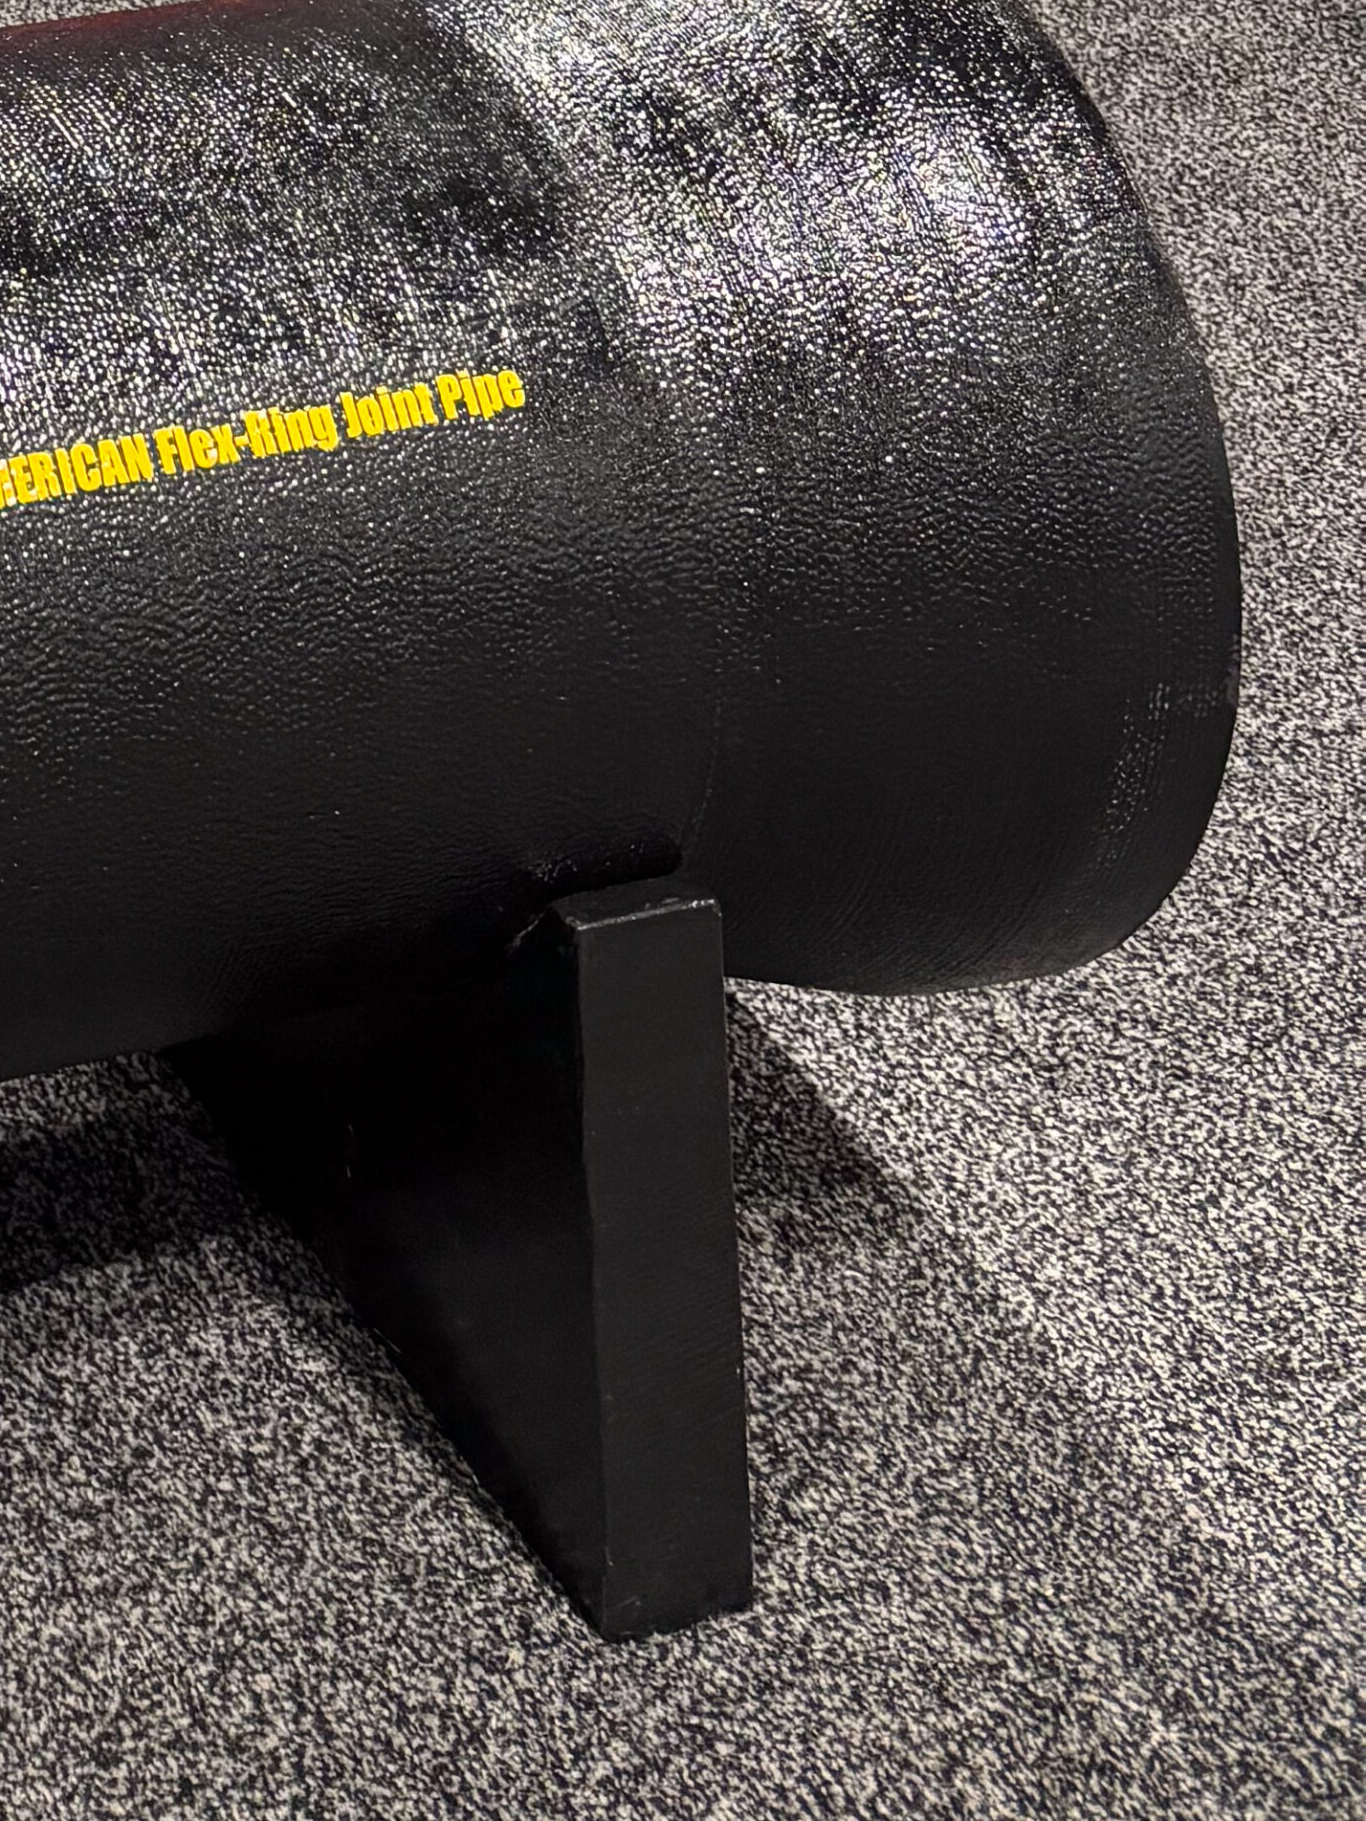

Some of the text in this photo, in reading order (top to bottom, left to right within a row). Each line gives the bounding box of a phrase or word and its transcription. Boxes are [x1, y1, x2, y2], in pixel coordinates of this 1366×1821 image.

[153, 404, 339, 475] Flex-Ring
[338, 382, 440, 439] Joint
[435, 367, 527, 422] Pipe
